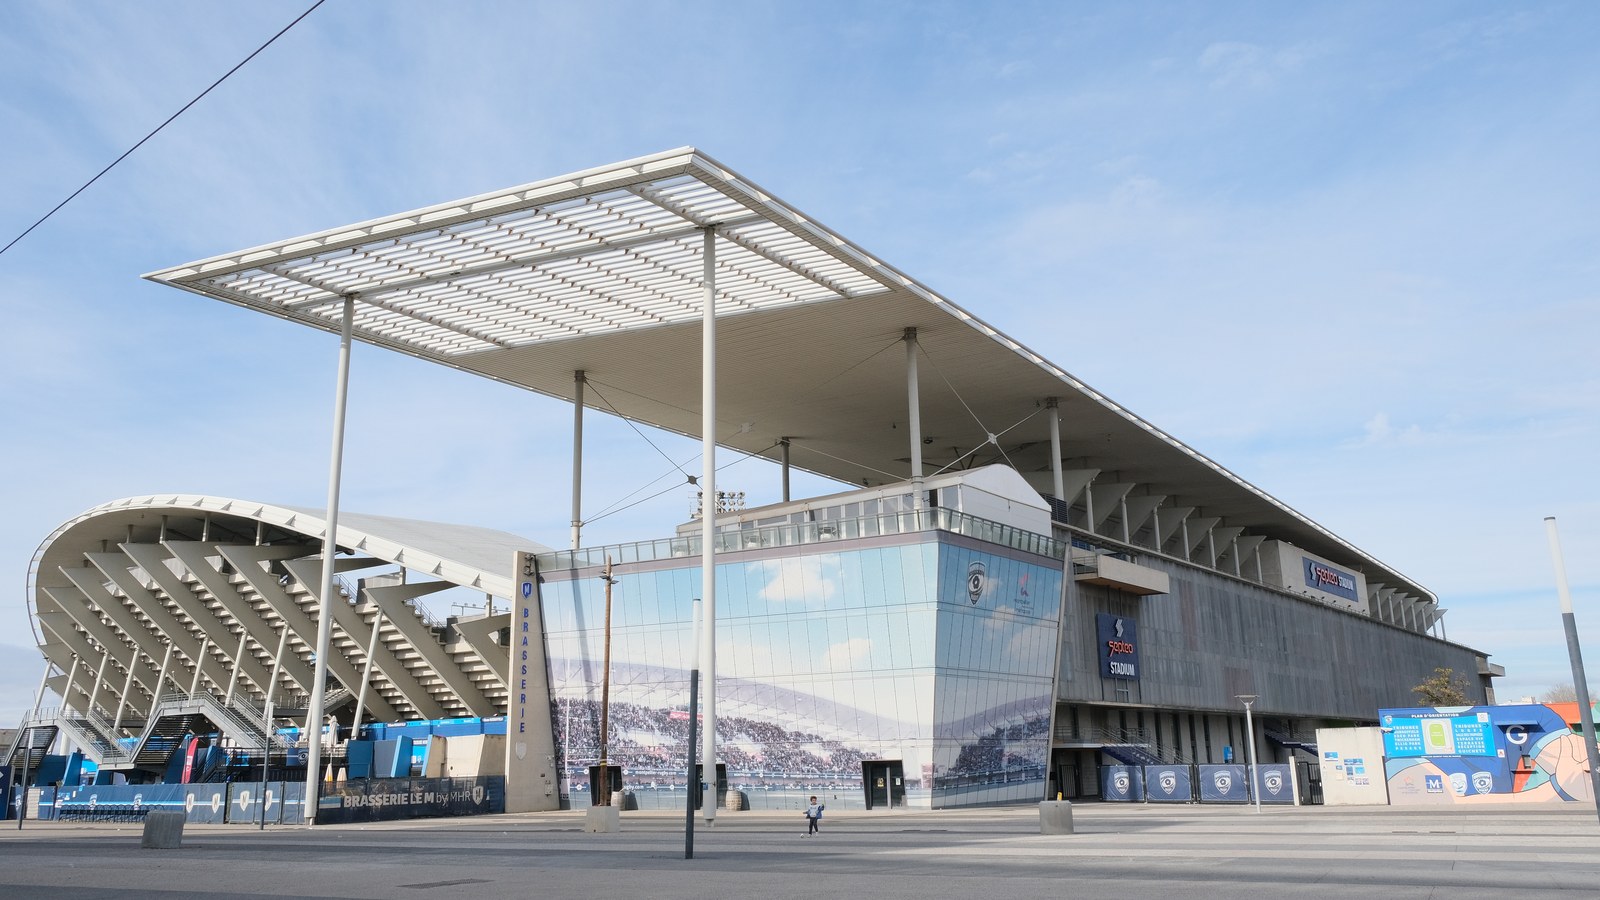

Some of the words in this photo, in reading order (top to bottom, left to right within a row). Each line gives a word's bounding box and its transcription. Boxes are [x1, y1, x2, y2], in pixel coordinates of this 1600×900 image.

[519, 608, 529, 733] BRASSERIE
[1110, 661, 1135, 676] STADIUM
[1506, 724, 1528, 745] G
[1429, 779, 1440, 789] M
[344, 793, 409, 808] BRASSERIE
[410, 792, 423, 805] LE
[424, 792, 435, 804] M
[436, 792, 449, 807] by
[450, 791, 471, 802] MHR
